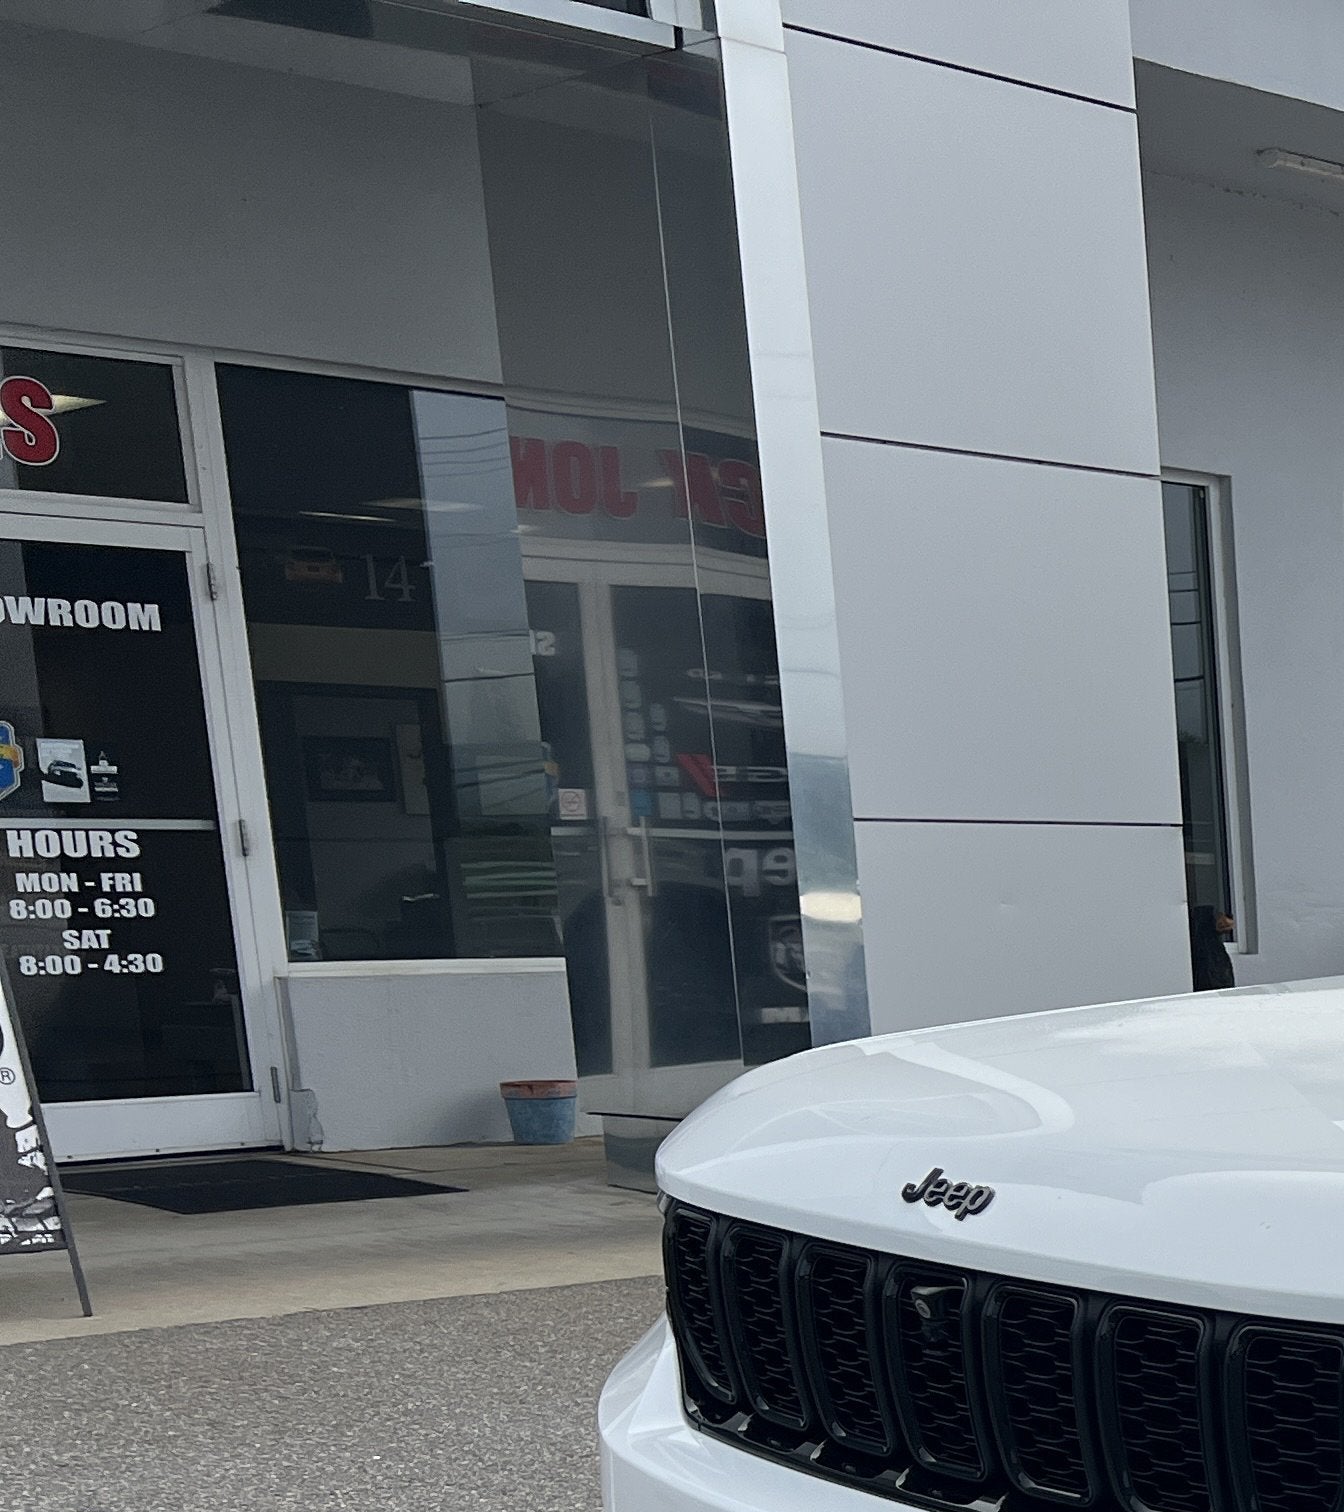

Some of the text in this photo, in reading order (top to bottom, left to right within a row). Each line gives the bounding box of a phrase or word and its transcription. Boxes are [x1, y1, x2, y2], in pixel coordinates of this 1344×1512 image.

[0, 595, 162, 632] WROOM
[6, 829, 141, 858] HOURS
[15, 872, 79, 893] MON
[100, 872, 143, 893] FRI
[9, 898, 72, 920] 8:00
[93, 897, 156, 919] 6:30
[61, 929, 112, 950] SAT
[18, 955, 82, 976] 8:00
[103, 953, 164, 973] 4:30
[901, 1167, 996, 1222] Jeep
